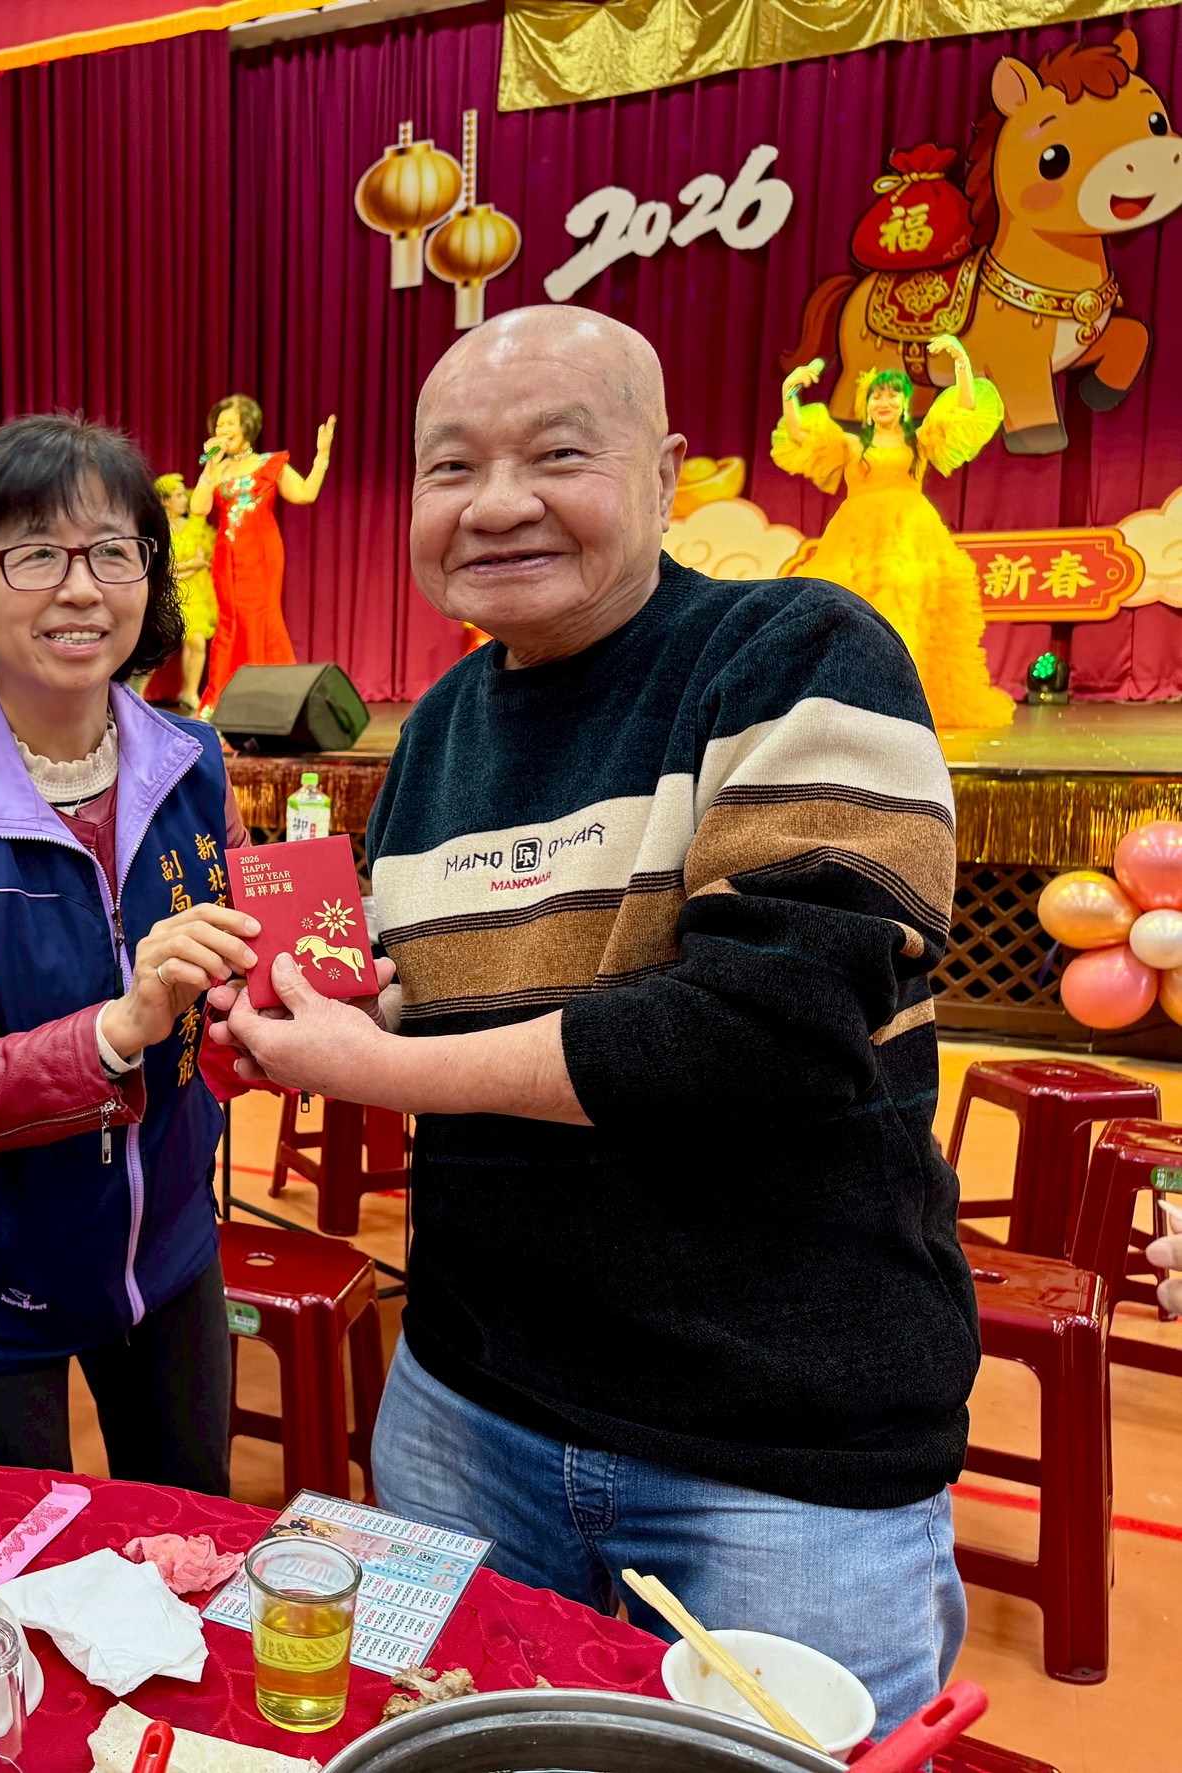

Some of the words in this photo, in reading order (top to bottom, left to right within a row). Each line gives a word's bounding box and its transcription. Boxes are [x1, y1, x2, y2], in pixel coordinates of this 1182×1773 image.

[543, 143, 794, 303] 2026
[879, 202, 934, 254] 福
[982, 549, 1096, 601] 新春
[239, 855, 260, 865] 2026
[241, 863, 272, 874] HAPPY
[444, 851, 504, 881] MANO
[243, 873, 265, 884] NEW
[266, 870, 291, 881] YEAR
[489, 871, 552, 892] MANOWAR
